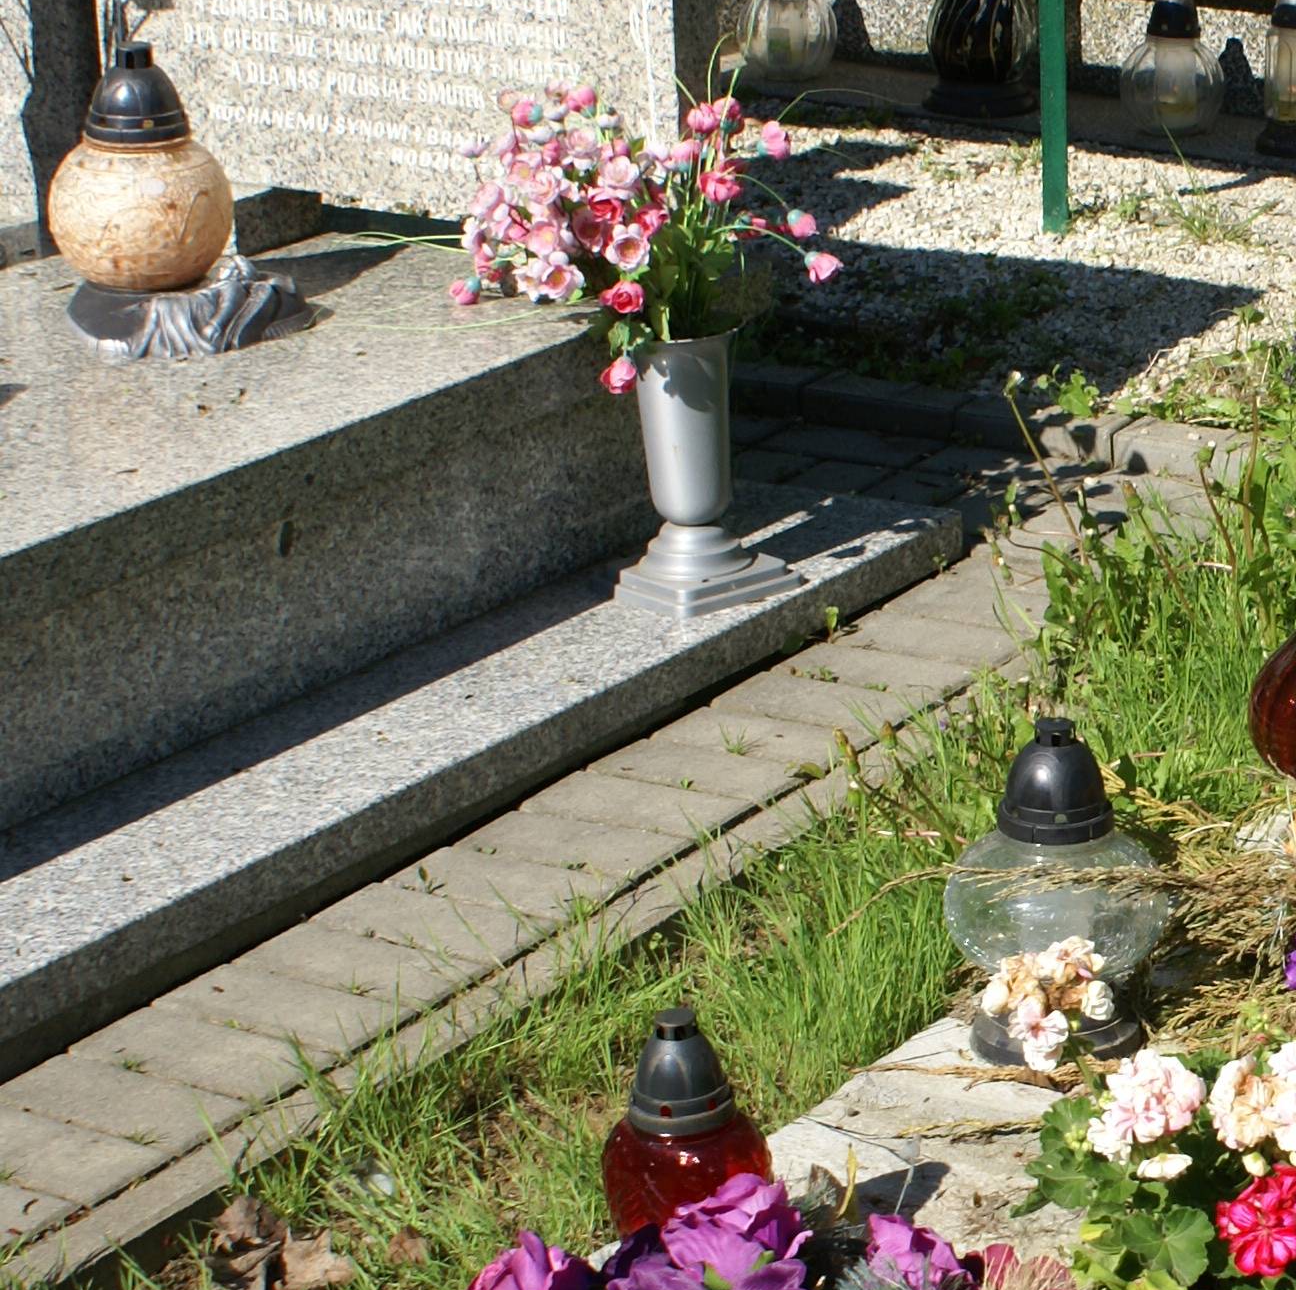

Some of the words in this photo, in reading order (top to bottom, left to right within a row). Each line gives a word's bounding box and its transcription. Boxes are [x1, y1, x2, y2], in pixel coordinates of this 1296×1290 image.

[297, 1, 328, 27] TAK
[333, 5, 386, 33] NAGLE
[393, 12, 424, 39] JAK
[183, 22, 219, 51] DLA
[223, 26, 280, 54] CIEBIE
[325, 38, 378, 65] TYLKO
[385, 44, 484, 77] MODLITWY
[248, 60, 280, 86] DLA
[285, 64, 321, 90] NAS
[416, 80, 486, 110] SMUTEK
[209, 103, 329, 134] KOCHANEMU
[333, 112, 408, 142] SYNOWI
